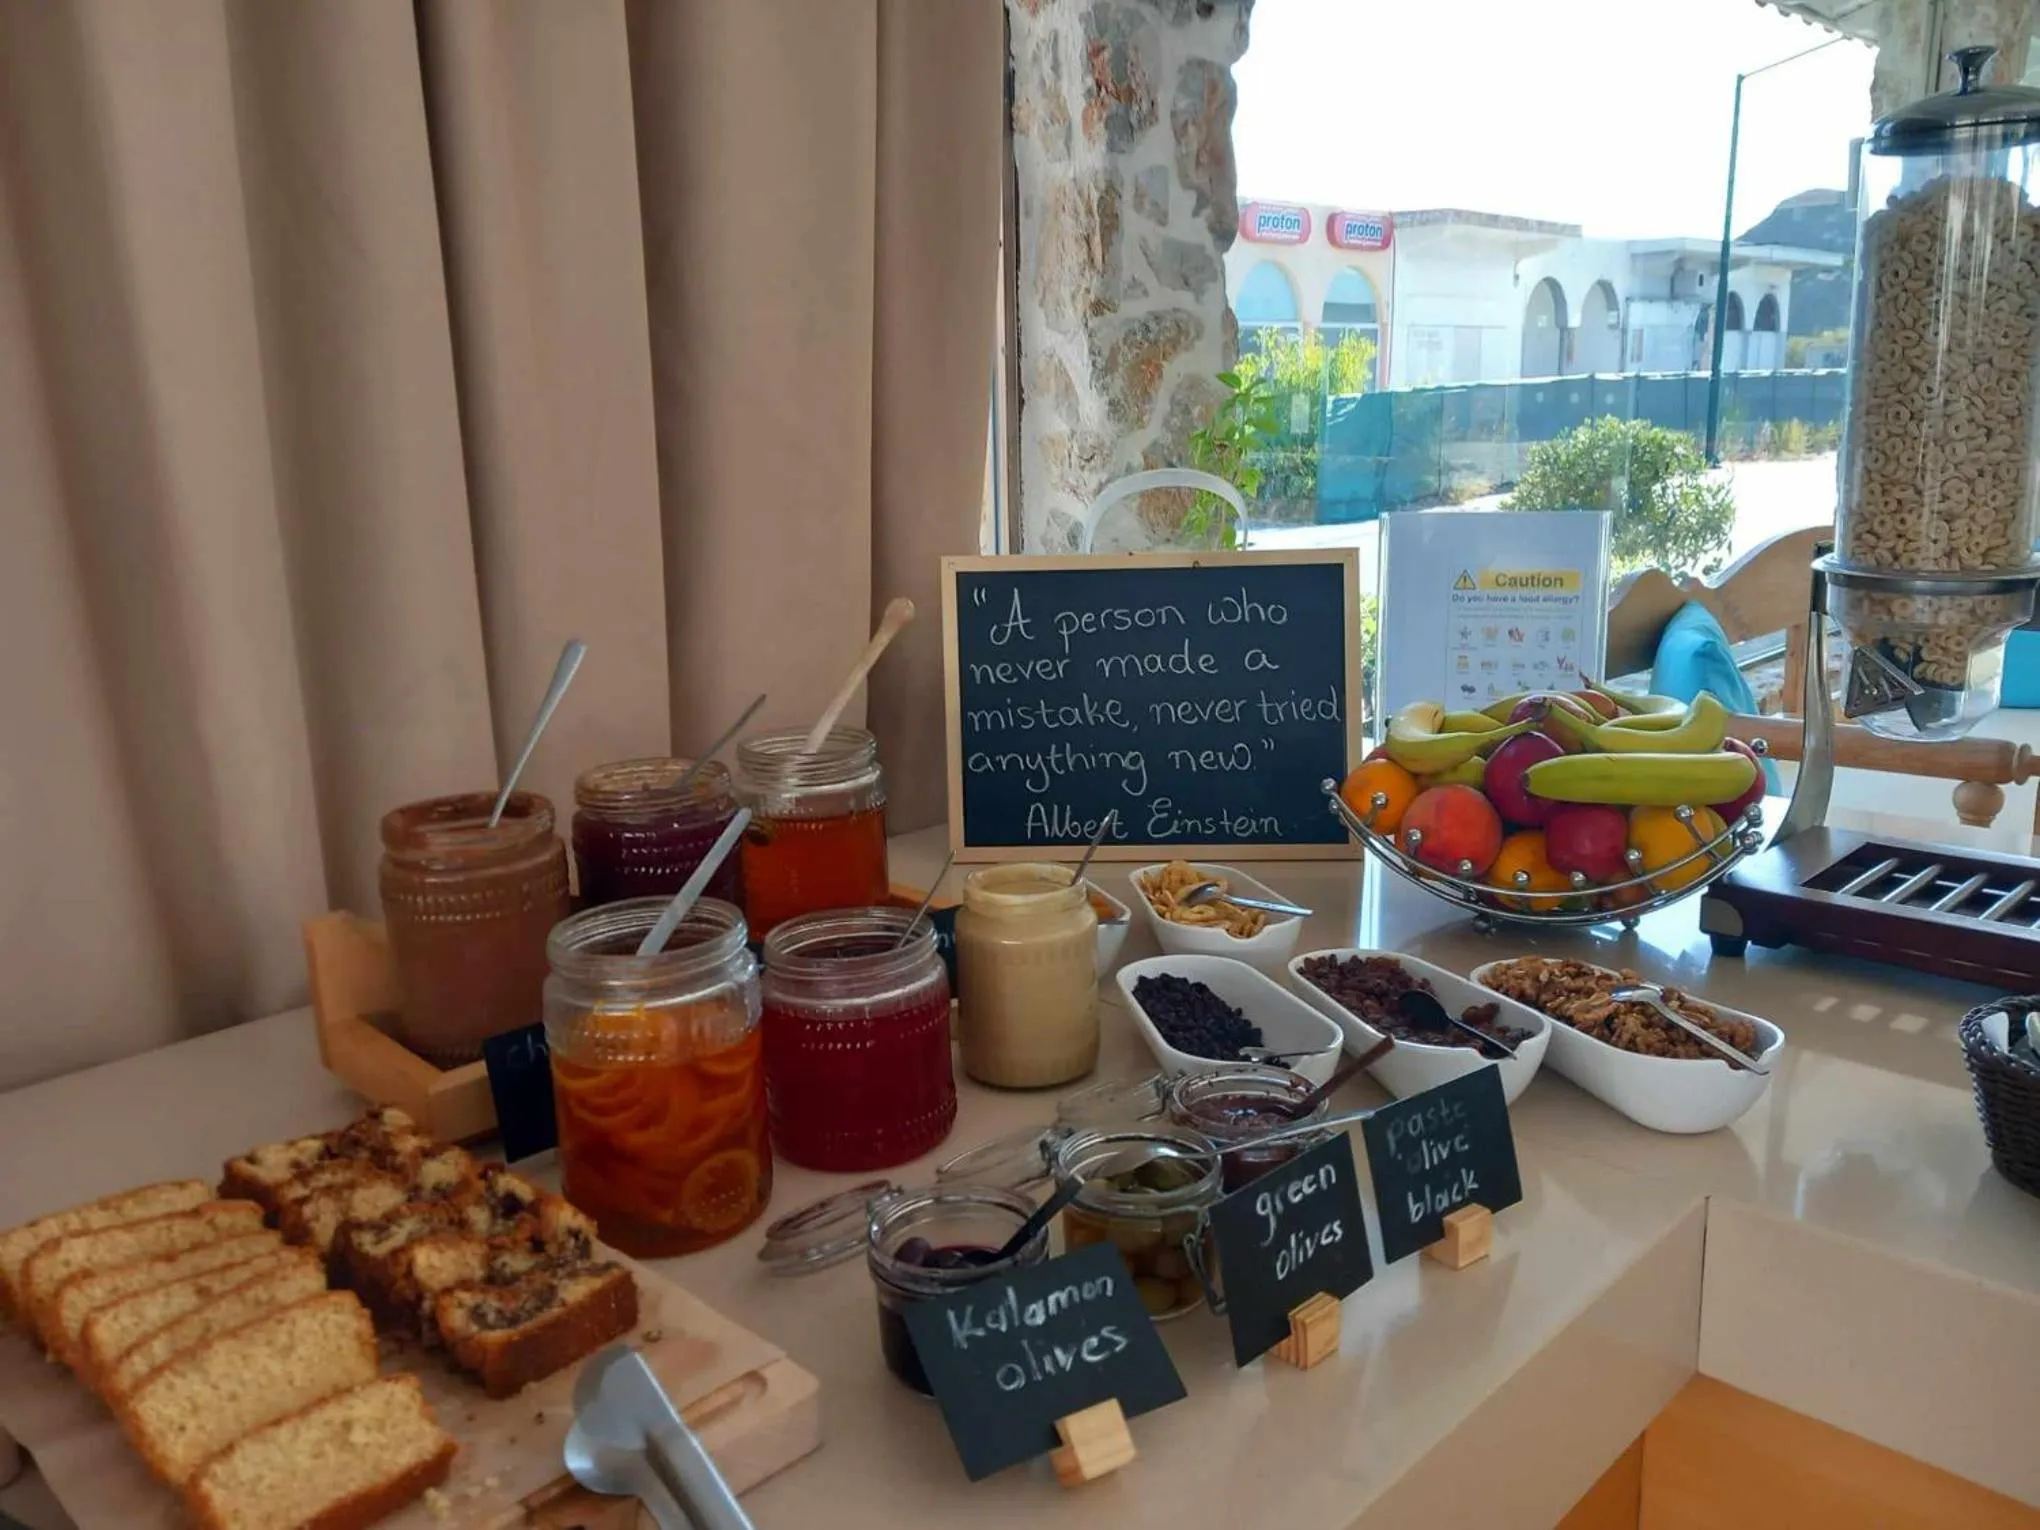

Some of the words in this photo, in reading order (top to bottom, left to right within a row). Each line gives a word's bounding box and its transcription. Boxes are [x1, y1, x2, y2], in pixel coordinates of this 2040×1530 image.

[1258, 213, 1300, 233] proton
[1345, 222, 1383, 241] proton
[1452, 594, 1465, 602] Do
[1467, 595, 1483, 603] you
[1487, 593, 1509, 602] have
[1542, 593, 1580, 605] allergy?
[1495, 572, 1564, 588] Caution
[1055, 604, 1186, 653] person
[1208, 586, 1288, 626] who
[968, 657, 1070, 686] never
[1096, 639, 1219, 679] made
[1243, 648, 1280, 671] a
[967, 693, 1139, 732] mistake,
[1148, 698, 1247, 726] never
[1257, 685, 1341, 727] tried
[968, 743, 1148, 796] anything
[1147, 796, 1283, 839] Einstein
[1386, 1097, 1468, 1159] paste
[1405, 1133, 1470, 1174] olive
[1255, 1163, 1337, 1248] green
[1406, 1167, 1480, 1225] black
[1275, 1219, 1344, 1281] olives
[946, 1276, 1115, 1350] Kalamon
[995, 1325, 1128, 1391] olives
